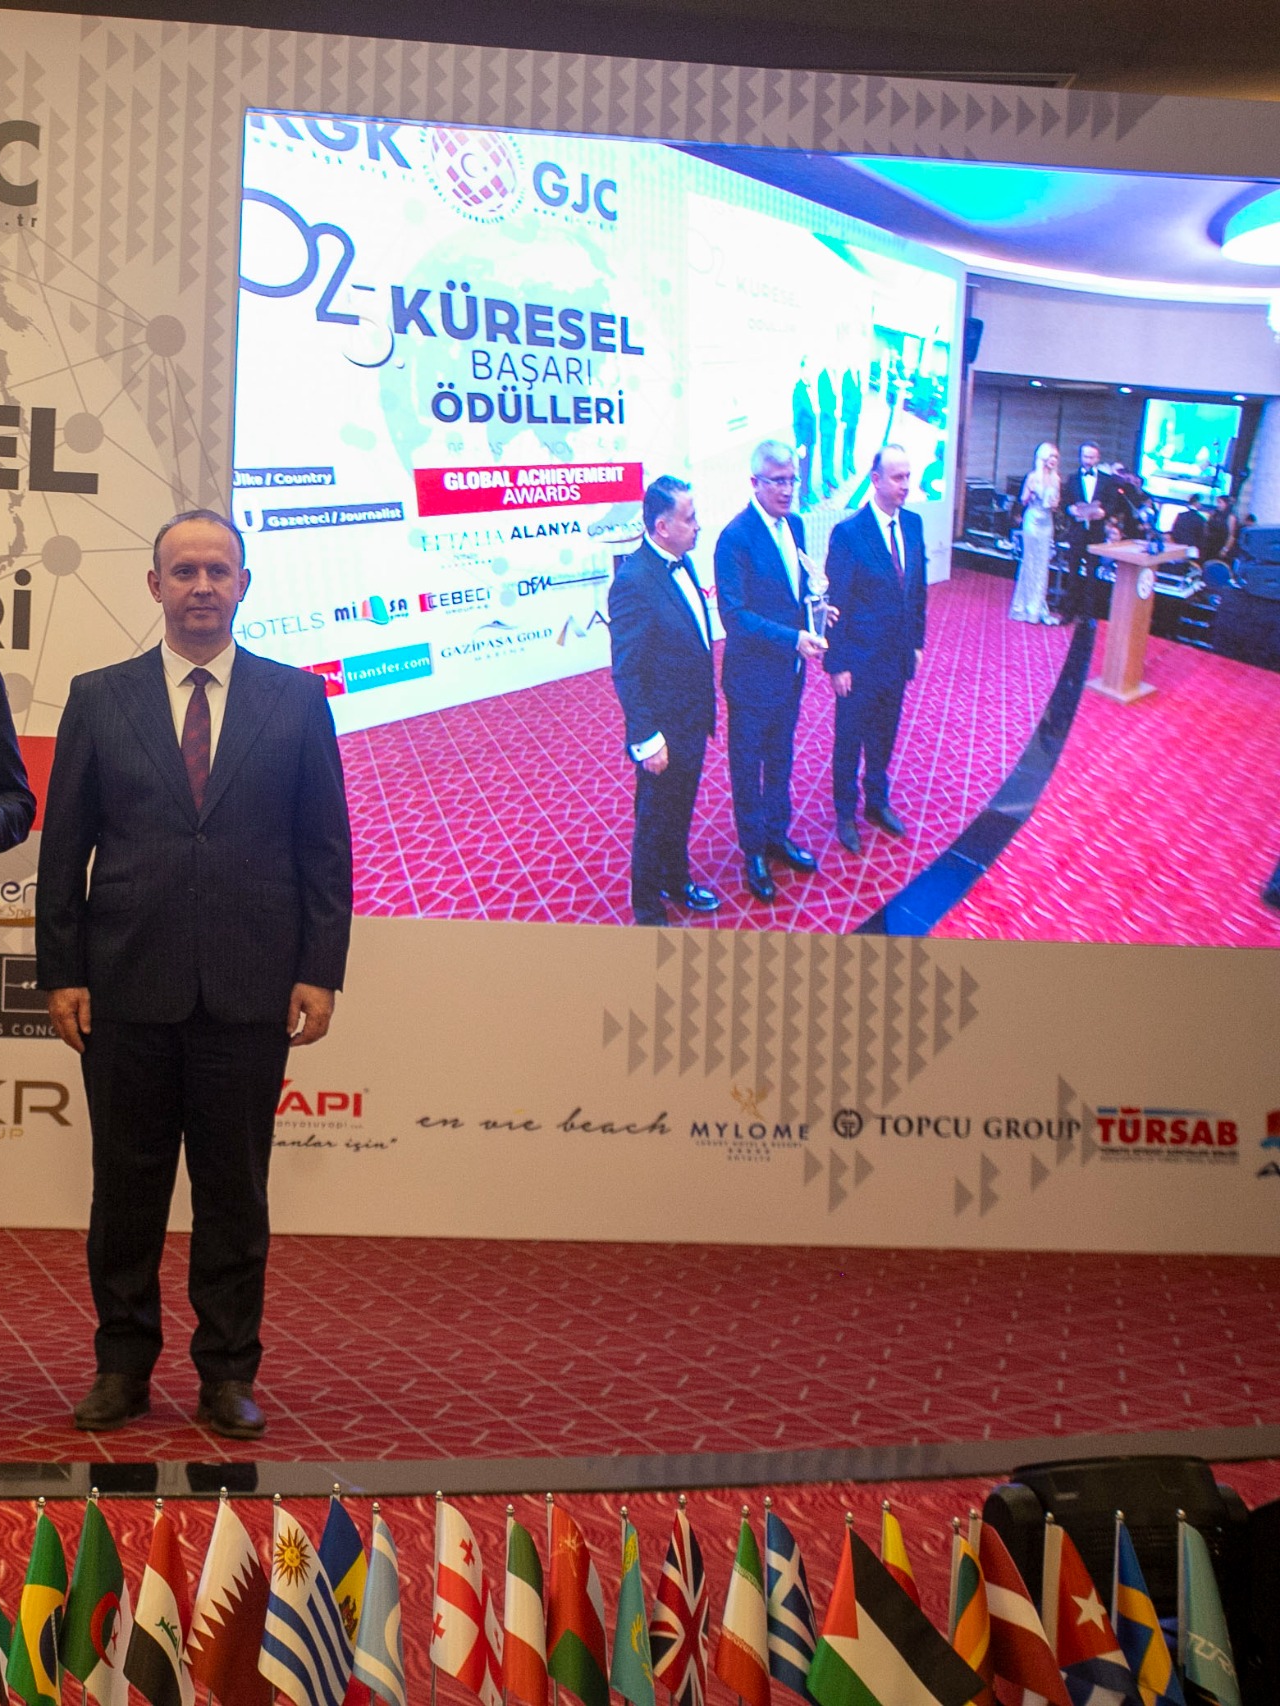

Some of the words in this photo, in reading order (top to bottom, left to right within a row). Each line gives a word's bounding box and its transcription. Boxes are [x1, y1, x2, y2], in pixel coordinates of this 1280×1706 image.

[532, 161, 618, 221] GJC
[390, 279, 645, 356] KÜRESEL
[470, 349, 593, 391] BAŞARI
[430, 381, 626, 425] ÖDÜLLERİ
[273, 471, 333, 485] Country
[443, 470, 513, 491] GLOBAL
[516, 466, 625, 487] ACHIEVEMENT
[502, 484, 582, 505] AWARDS
[267, 511, 330, 527] Gazeteci
[339, 507, 402, 522] Journalist
[510, 521, 582, 540] ALANYA
[556, 1106, 673, 1136] beach
[690, 1121, 811, 1141] MYLOME
[876, 1114, 973, 1140] TOPCU
[983, 1116, 1082, 1142] GROUP
